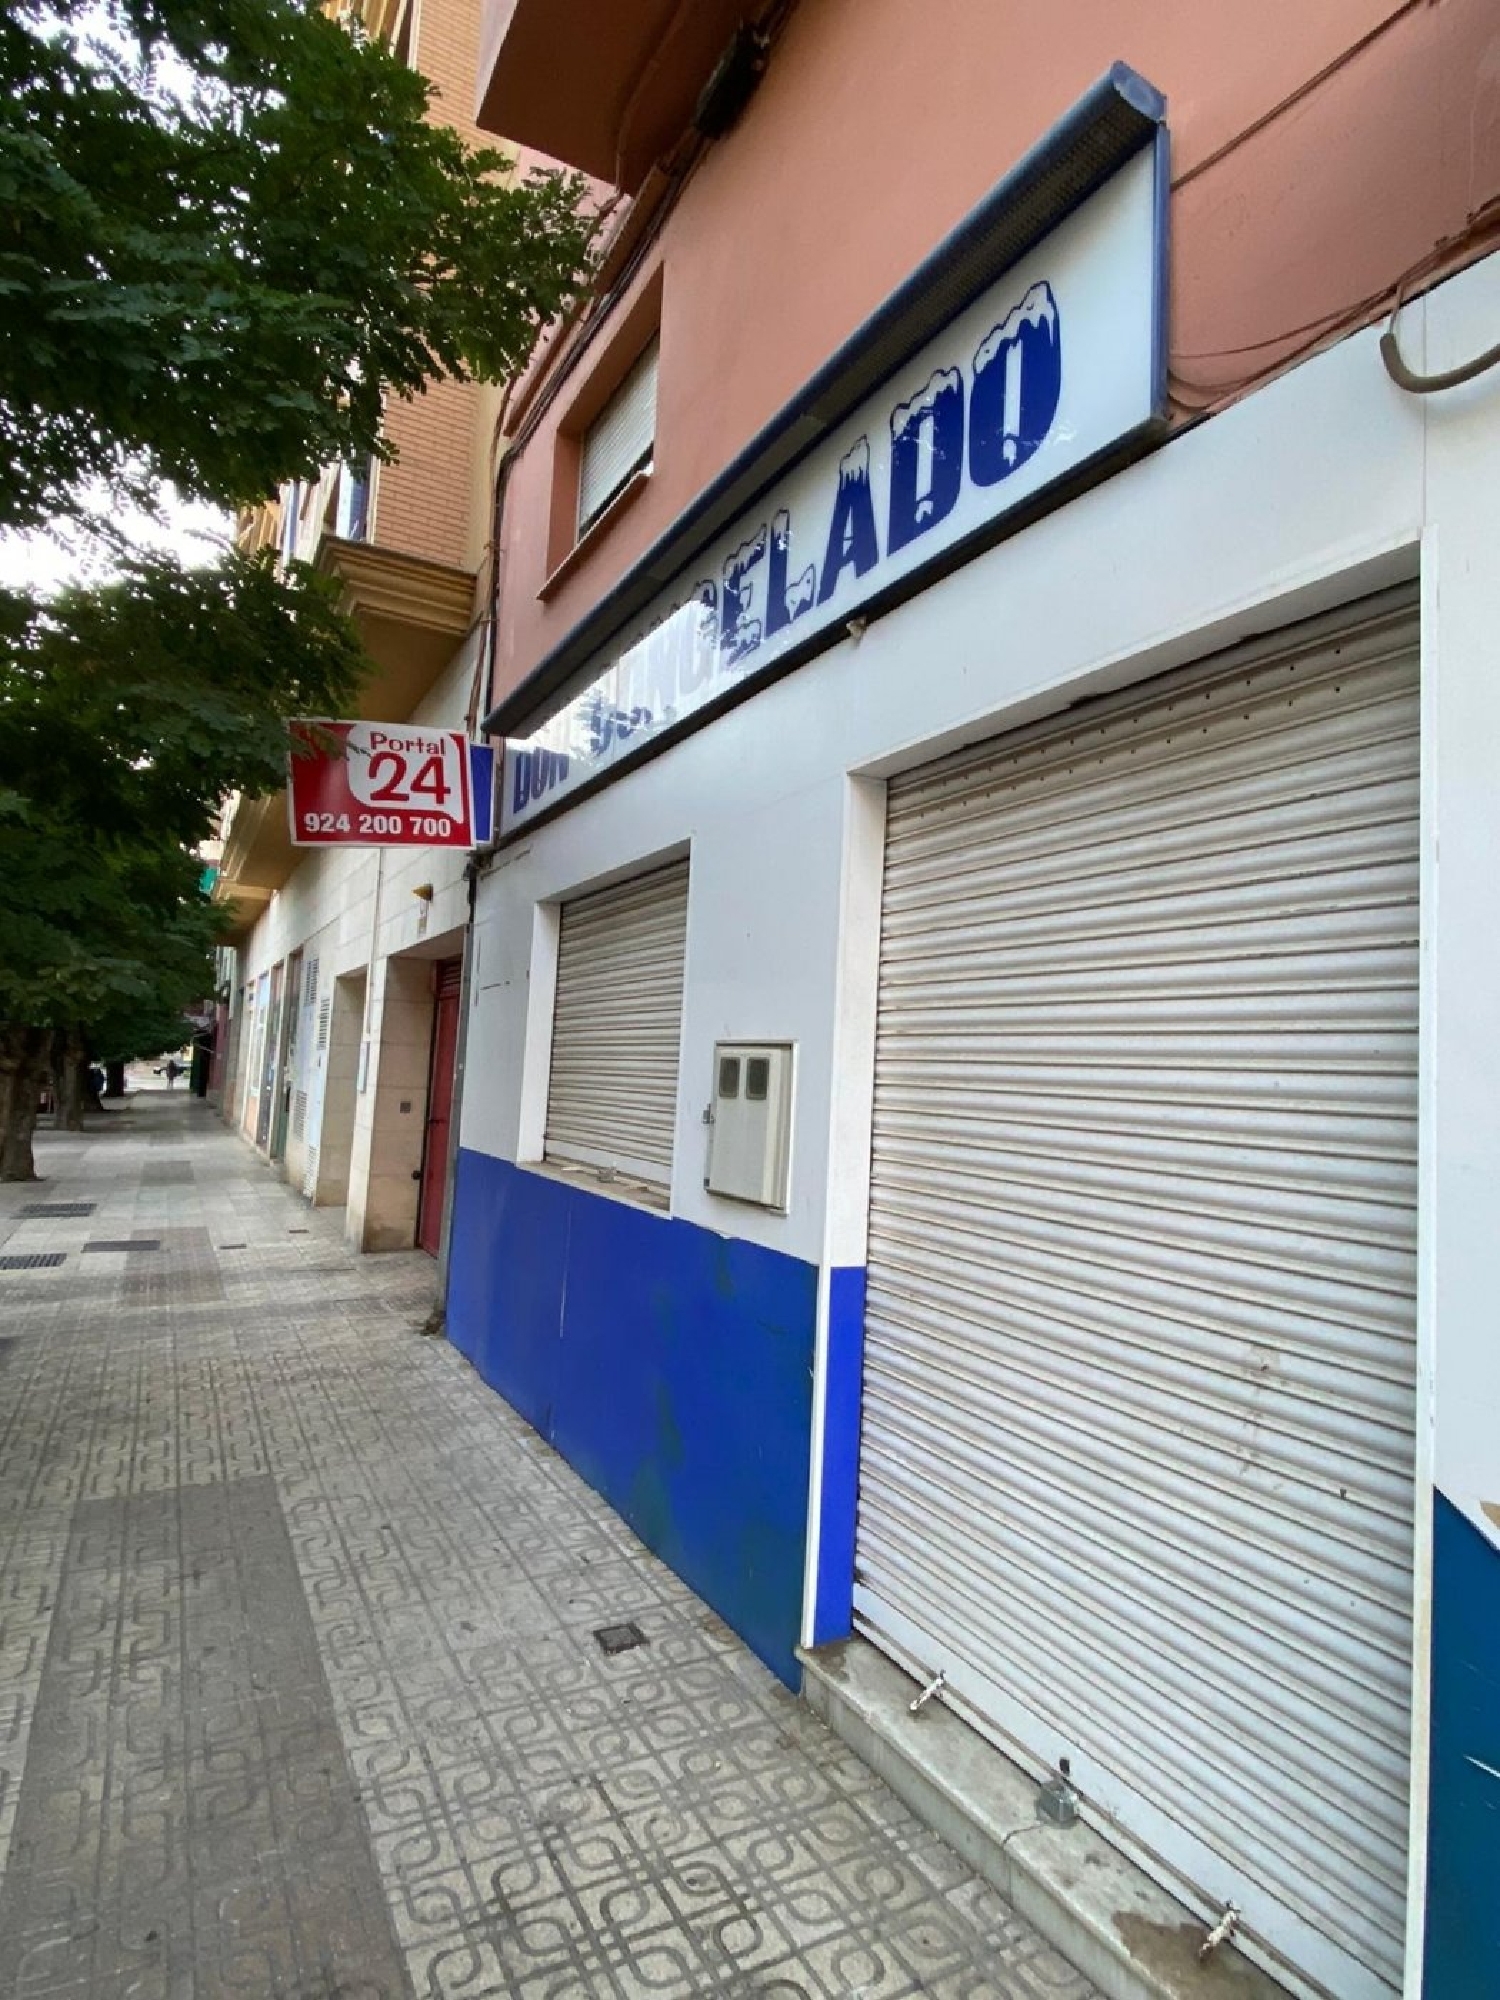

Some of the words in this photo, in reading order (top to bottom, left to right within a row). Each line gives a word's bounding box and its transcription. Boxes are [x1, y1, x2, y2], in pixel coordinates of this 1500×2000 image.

[369, 731, 446, 756] Portal
[368, 751, 451, 805] 24
[304, 812, 351, 833] 924
[358, 814, 402, 835] 200
[409, 816, 451, 837] 700
